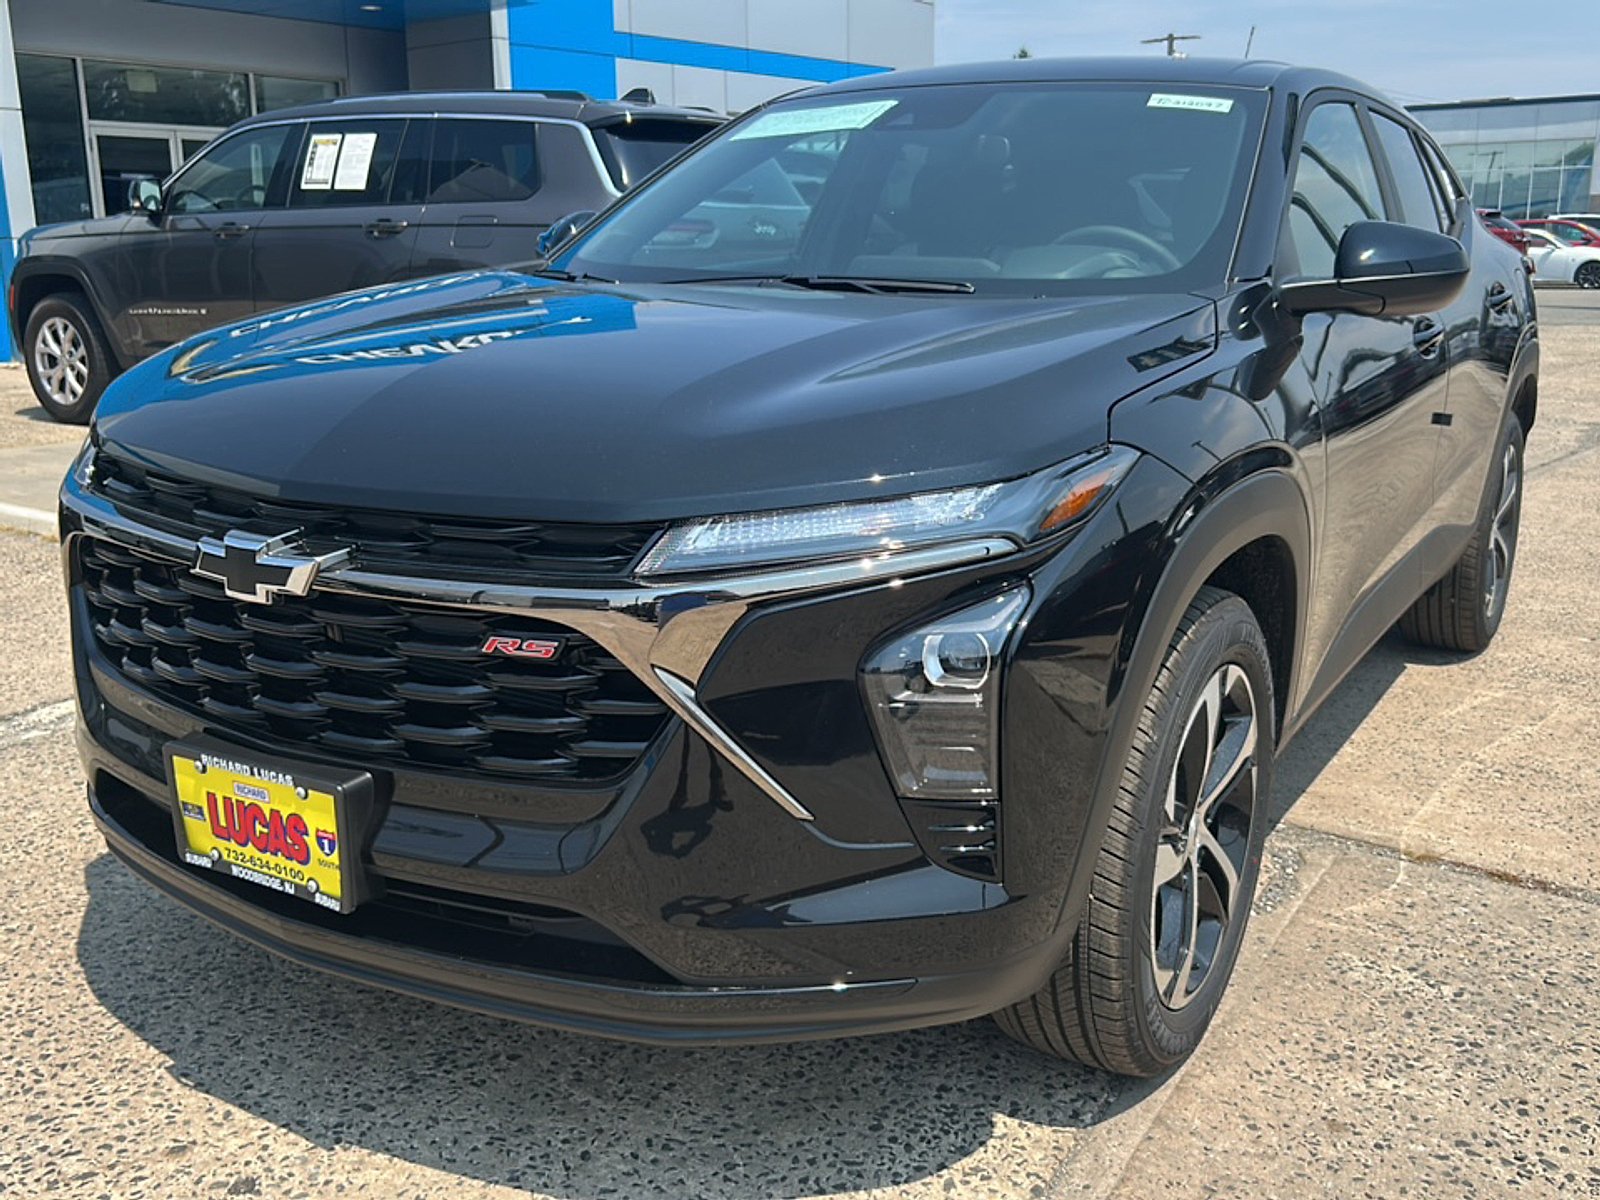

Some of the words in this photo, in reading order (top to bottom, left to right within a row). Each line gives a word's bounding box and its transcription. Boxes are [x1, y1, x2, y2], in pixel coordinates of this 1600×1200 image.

[482, 636, 559, 658] RS
[201, 754, 251, 776] RICHARD
[253, 766, 294, 786] LUCAS
[207, 791, 311, 865] LUCAS
[224, 847, 304, 881] 732-634-0100
